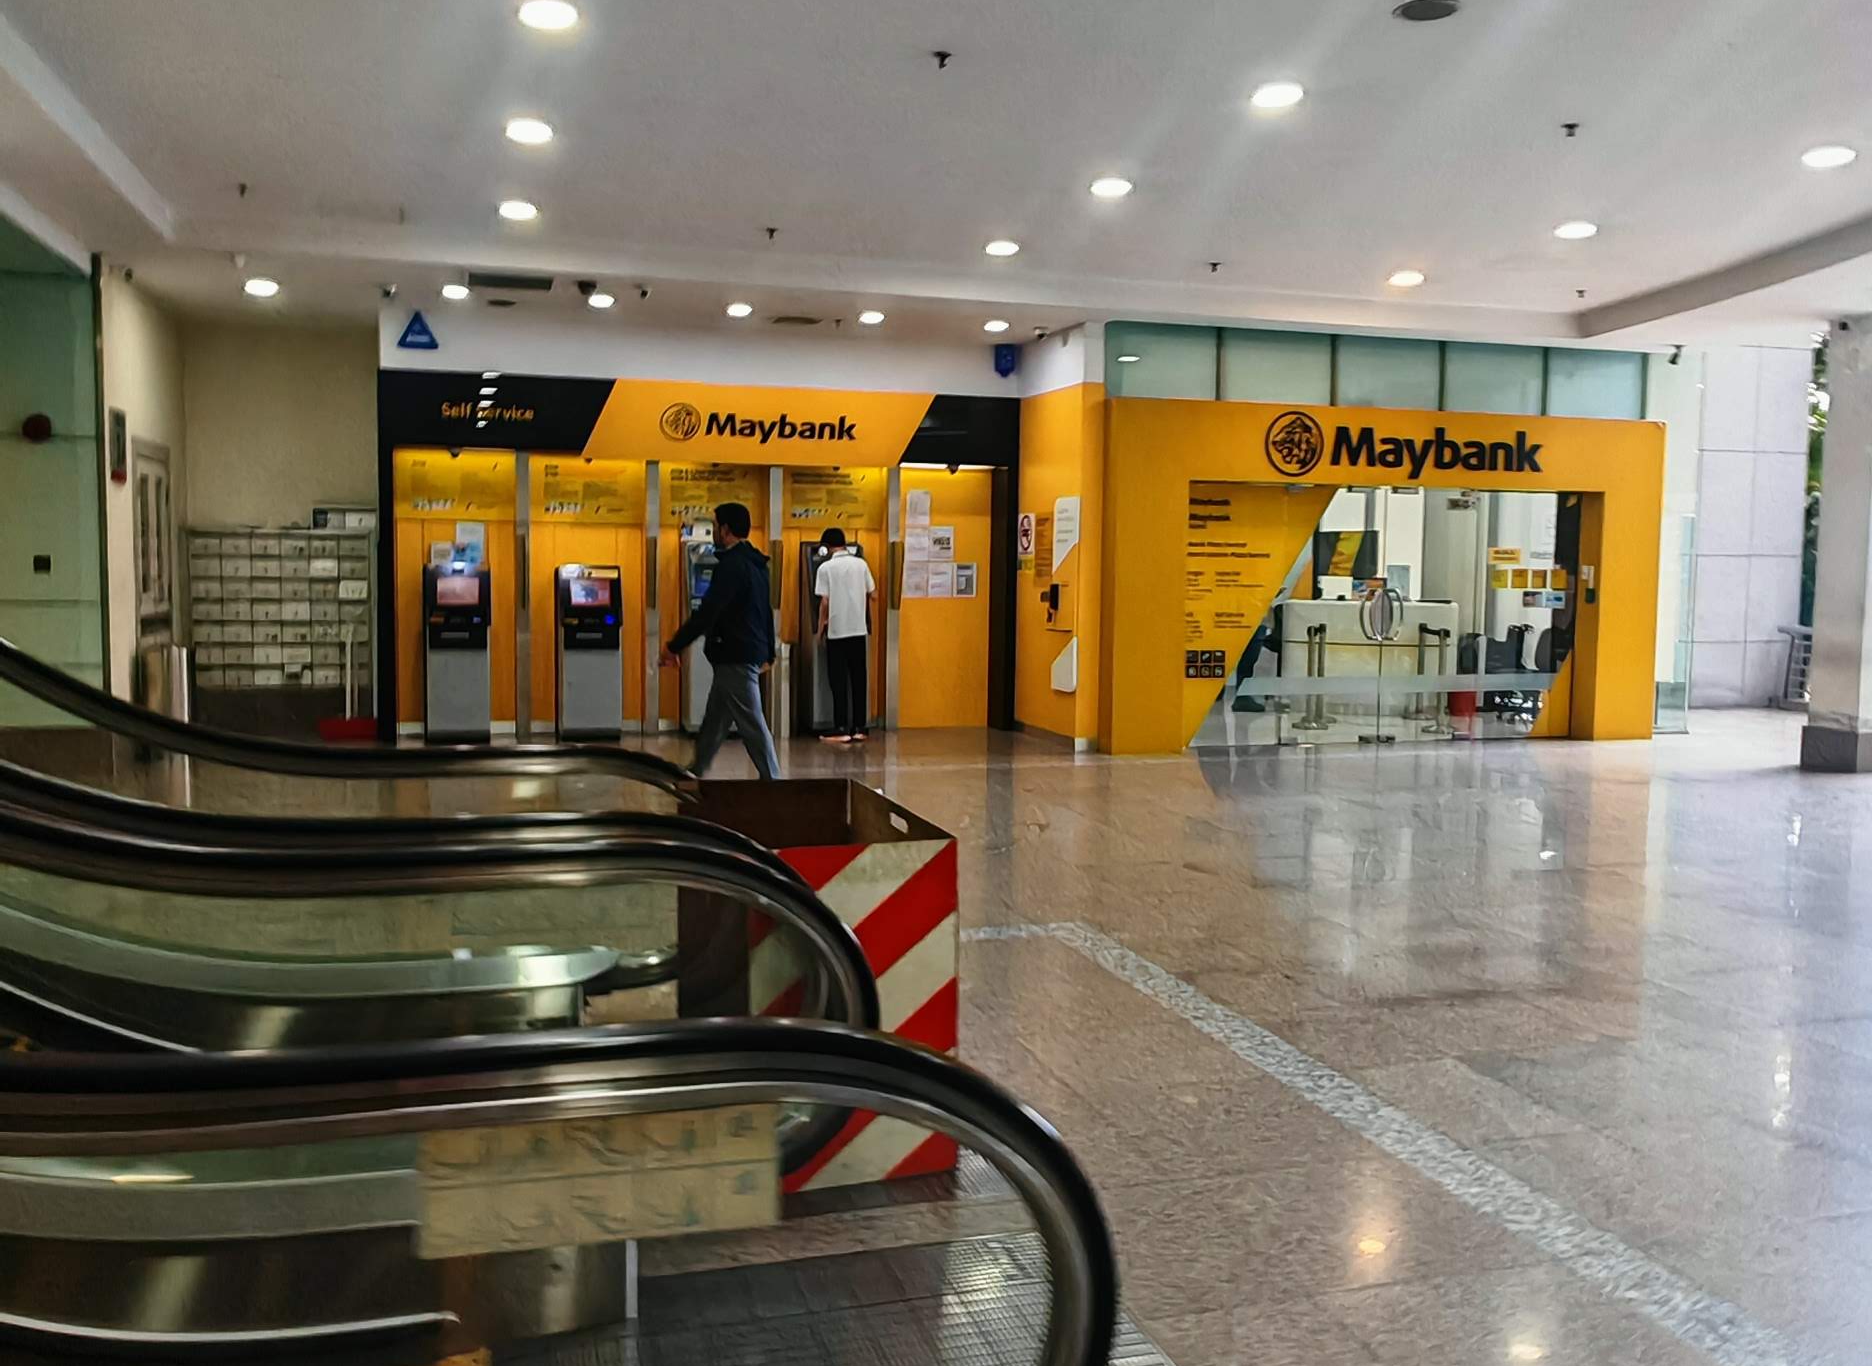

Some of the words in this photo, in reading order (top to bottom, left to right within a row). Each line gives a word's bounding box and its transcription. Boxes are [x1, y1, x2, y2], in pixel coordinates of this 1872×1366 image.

[441, 401, 473, 420] Self
[705, 412, 857, 444] Maybank
[1330, 426, 1543, 480] Maybank
